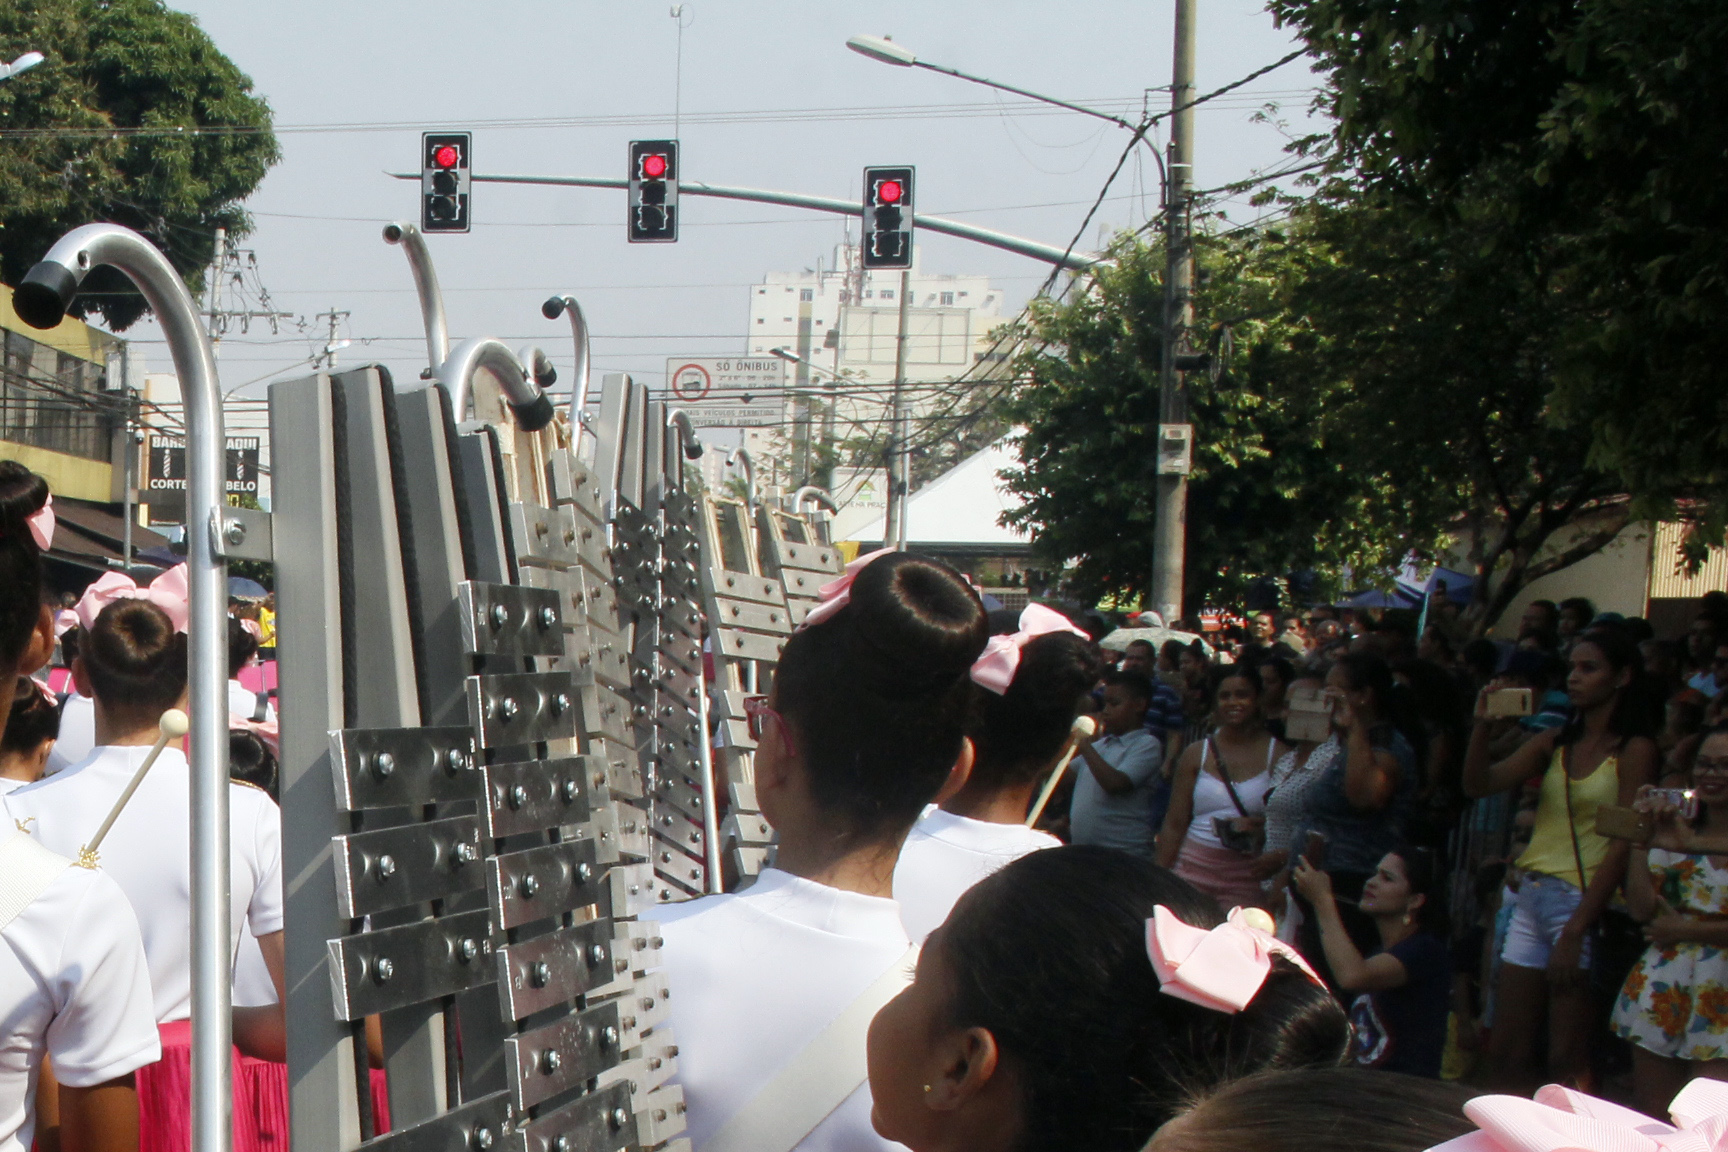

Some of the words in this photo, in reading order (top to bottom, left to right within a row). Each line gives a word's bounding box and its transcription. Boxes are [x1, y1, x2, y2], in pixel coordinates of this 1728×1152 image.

[716, 359, 730, 371] SÓ
[736, 359, 778, 371] ÔNIBUS
[226, 438, 257, 450] AQUI
[150, 479, 187, 490] CORTE
[226, 481, 256, 491] BELO
